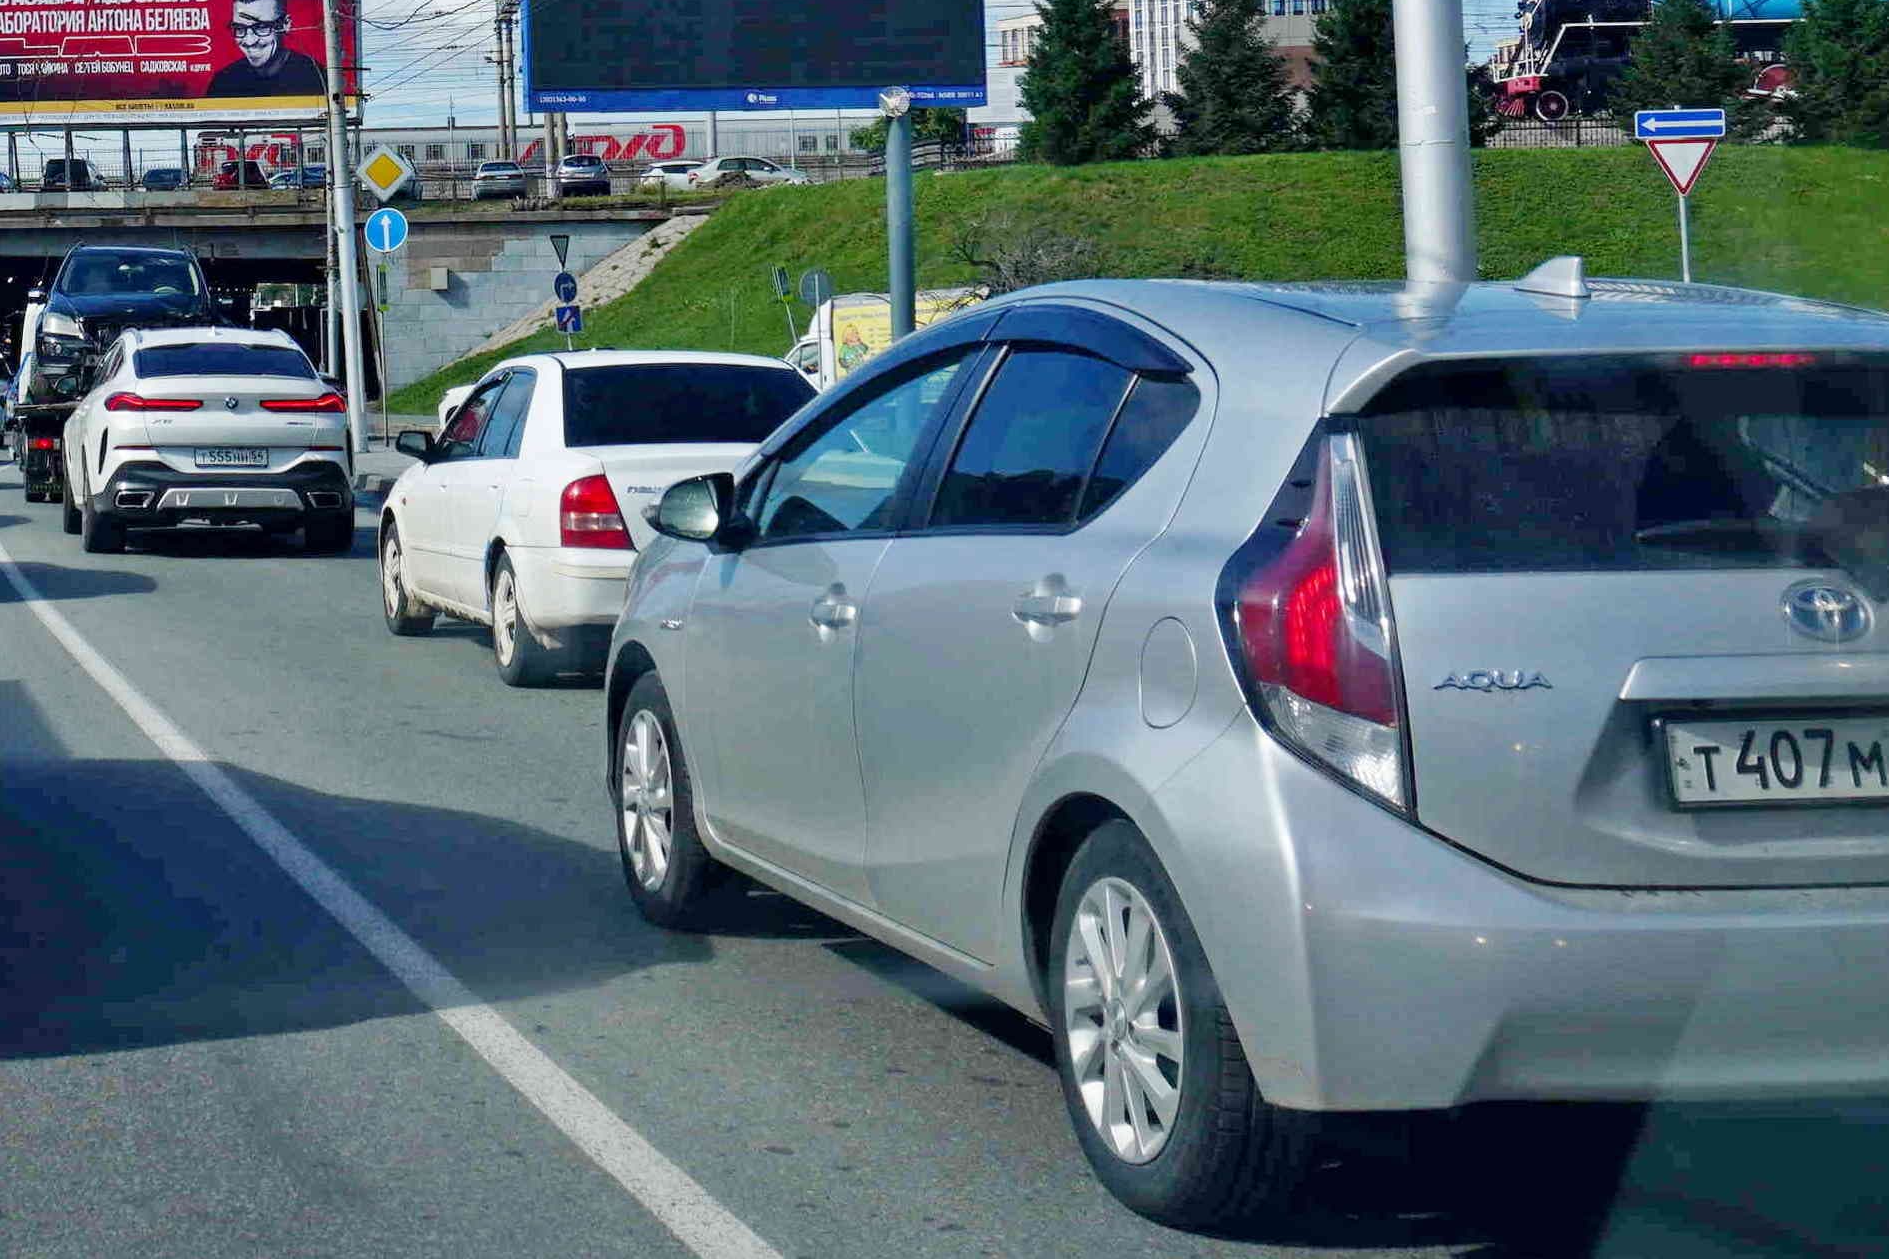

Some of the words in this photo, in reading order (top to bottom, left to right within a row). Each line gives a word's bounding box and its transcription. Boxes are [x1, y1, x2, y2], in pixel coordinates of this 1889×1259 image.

[87, 8, 142, 33] АНТОНА
[145, 7, 210, 31] БЕЛЯЕВА
[74, 60, 101, 74] СЕРГЕЙ
[101, 60, 134, 73] БОБУНЕЦ
[140, 60, 187, 73] САДКОВСКАЯ
[1432, 669, 1554, 692] AQUA
[1692, 727, 1888, 791] Т407М
